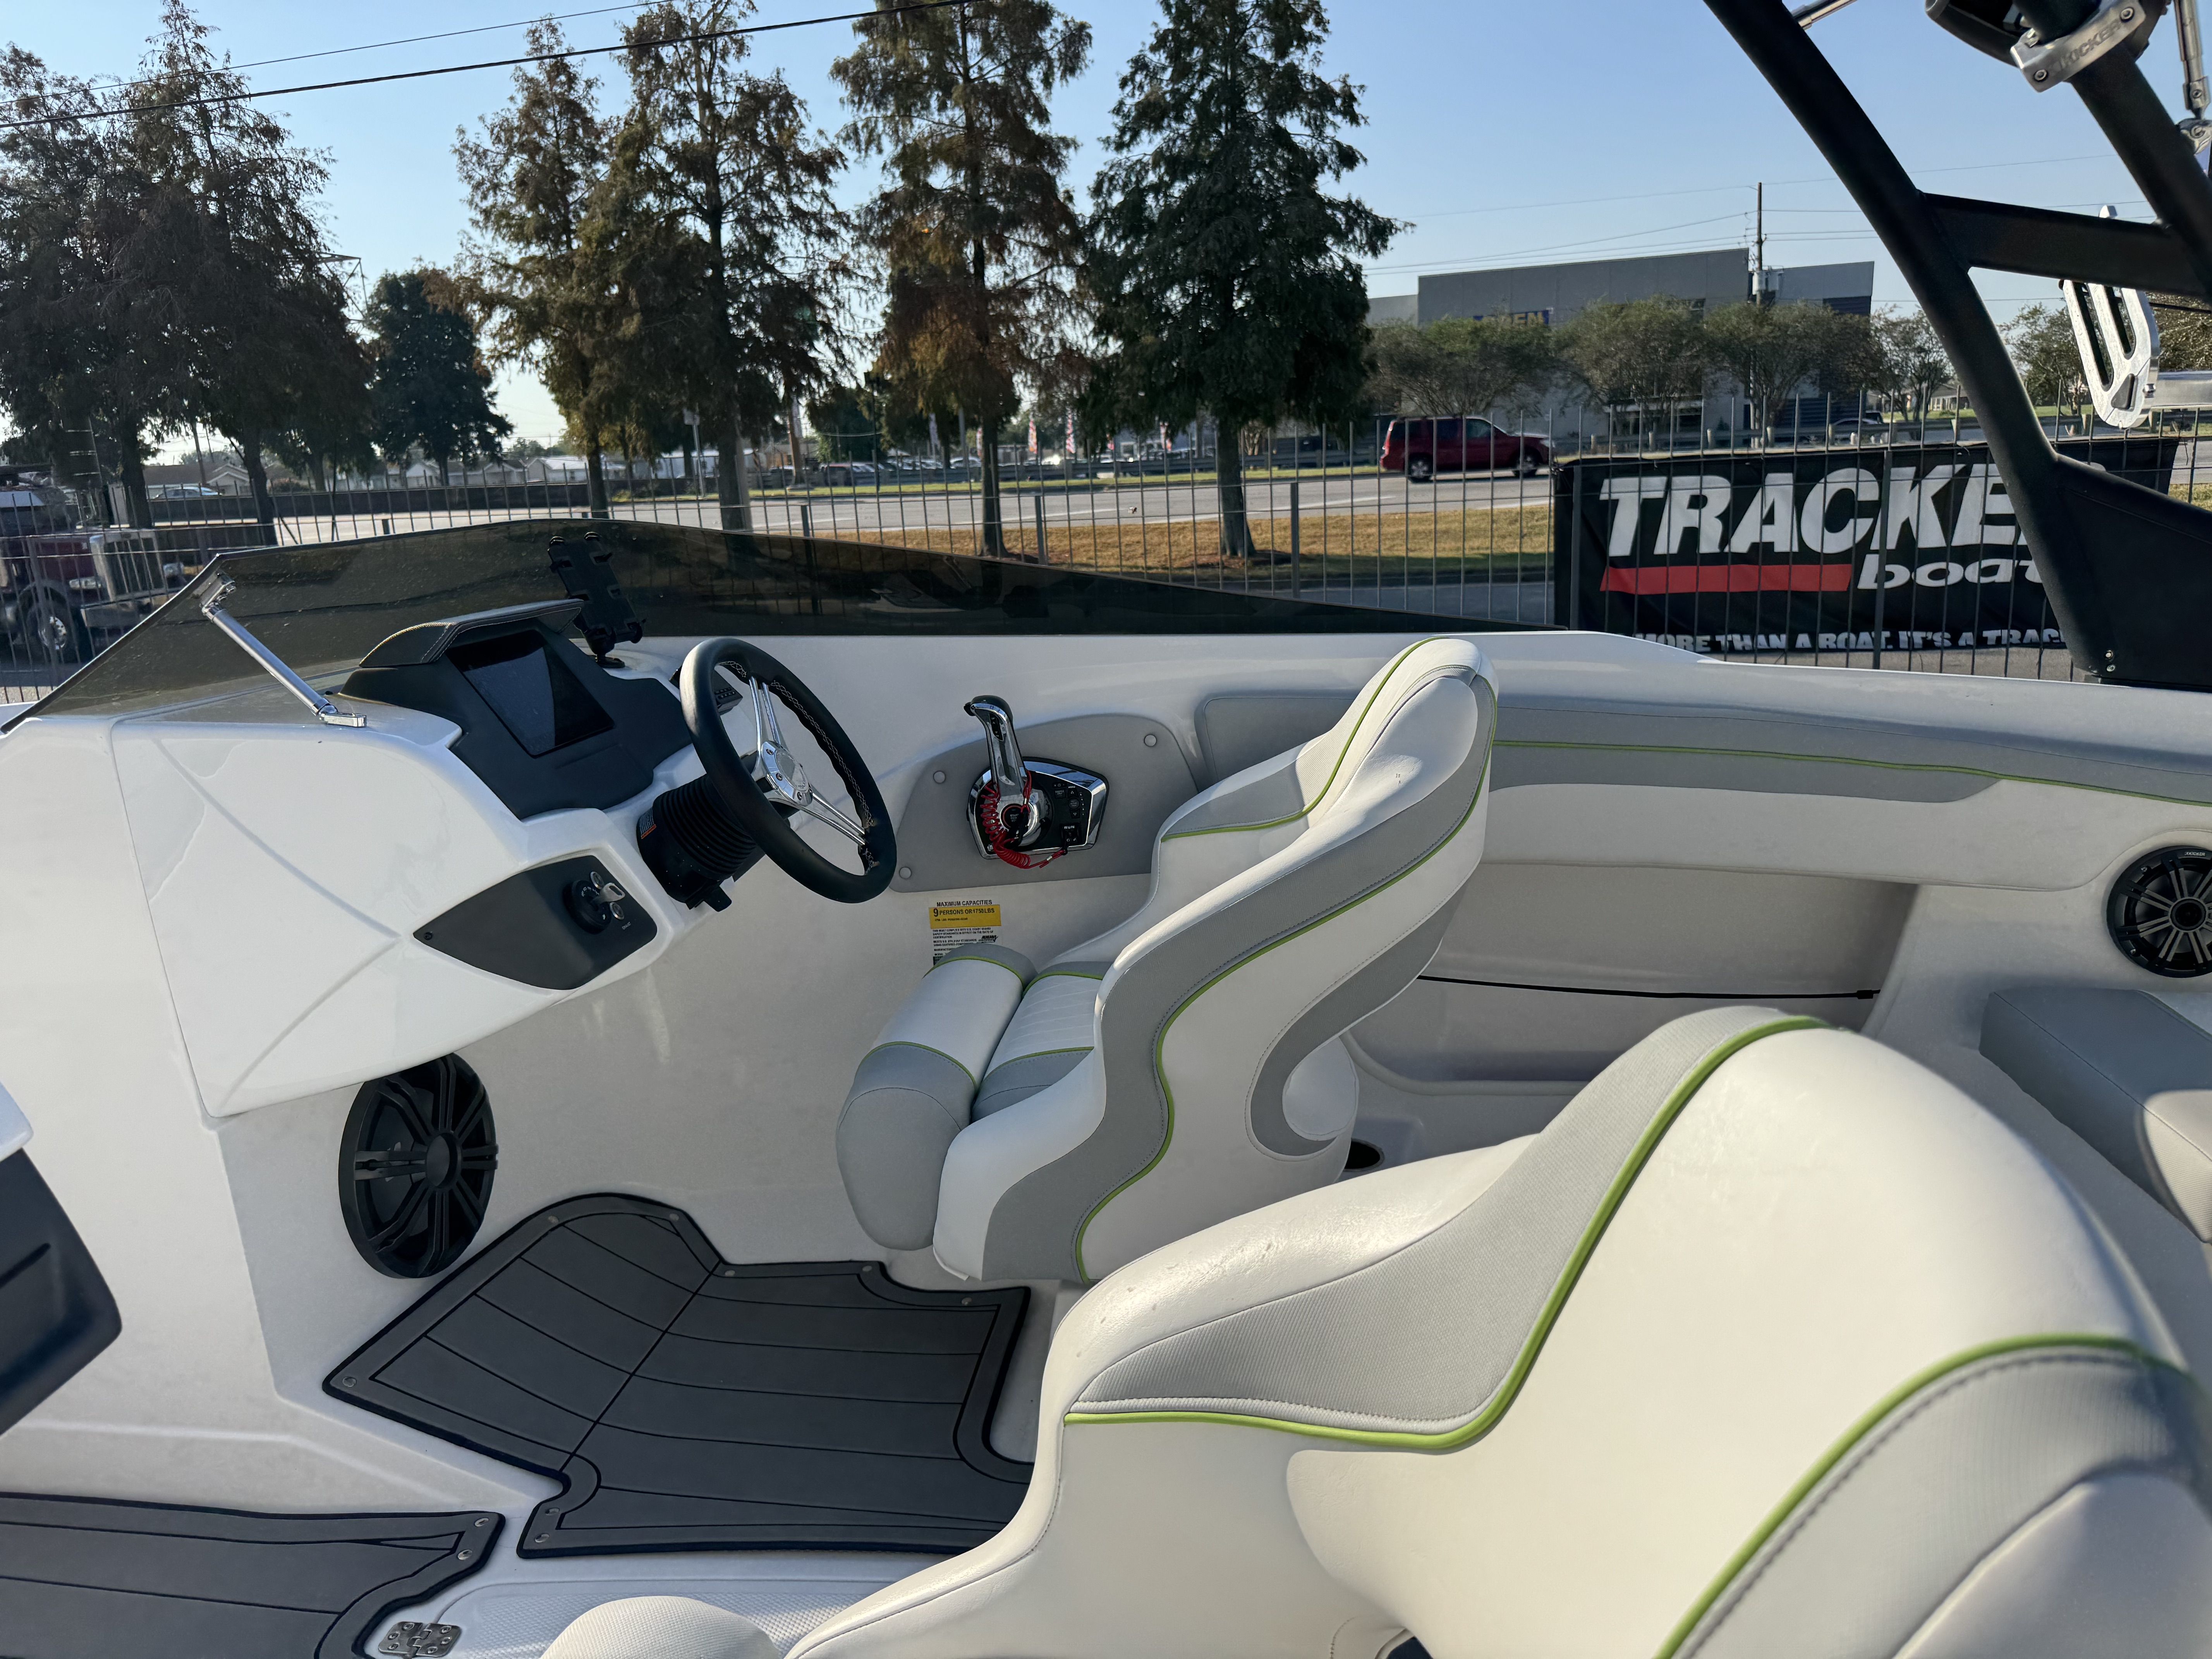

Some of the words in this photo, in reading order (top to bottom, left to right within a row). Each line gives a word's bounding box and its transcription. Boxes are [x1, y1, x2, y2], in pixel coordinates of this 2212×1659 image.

[1599, 462, 2106, 556] TRACKE
[1715, 634, 1786, 651] THAN
[1795, 633, 1811, 648] A
[1898, 630, 1951, 648] IT'S
[1958, 632, 1973, 646] A
[1982, 629, 2065, 645] TRAC
[933, 908, 939, 917] 9
